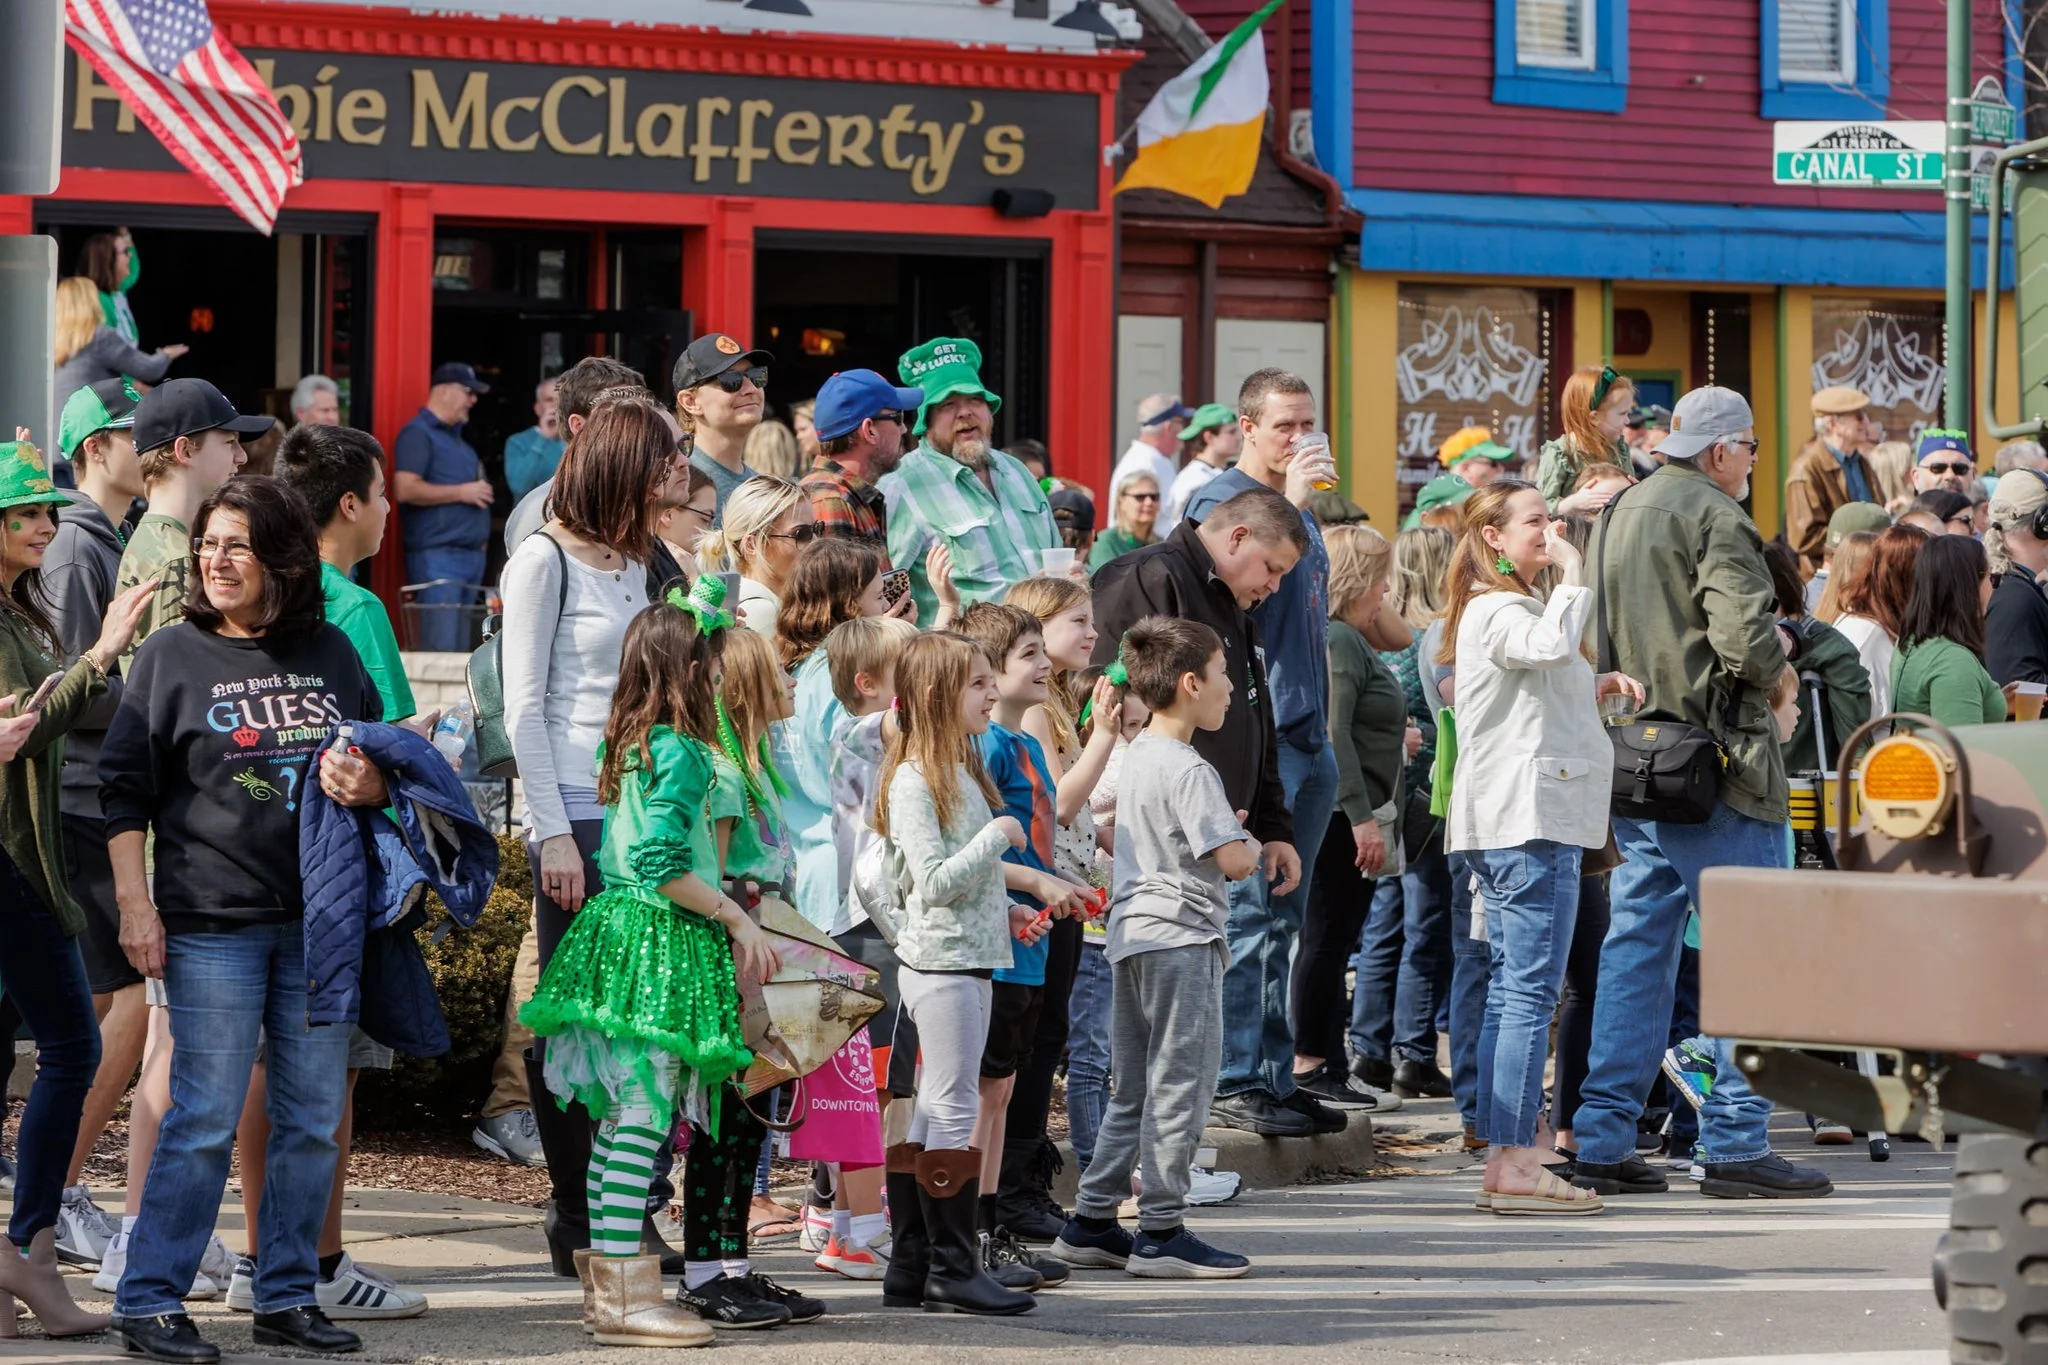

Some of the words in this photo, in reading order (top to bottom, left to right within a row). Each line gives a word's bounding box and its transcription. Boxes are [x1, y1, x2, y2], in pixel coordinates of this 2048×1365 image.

[410, 68, 1026, 194] McClafferty's
[1789, 152, 1873, 180] CANAL
[1895, 152, 1927, 180] ST
[933, 343, 957, 356] GET
[927, 353, 967, 371] LUCKY
[211, 682, 246, 698] New
[206, 691, 343, 734] GUESS
